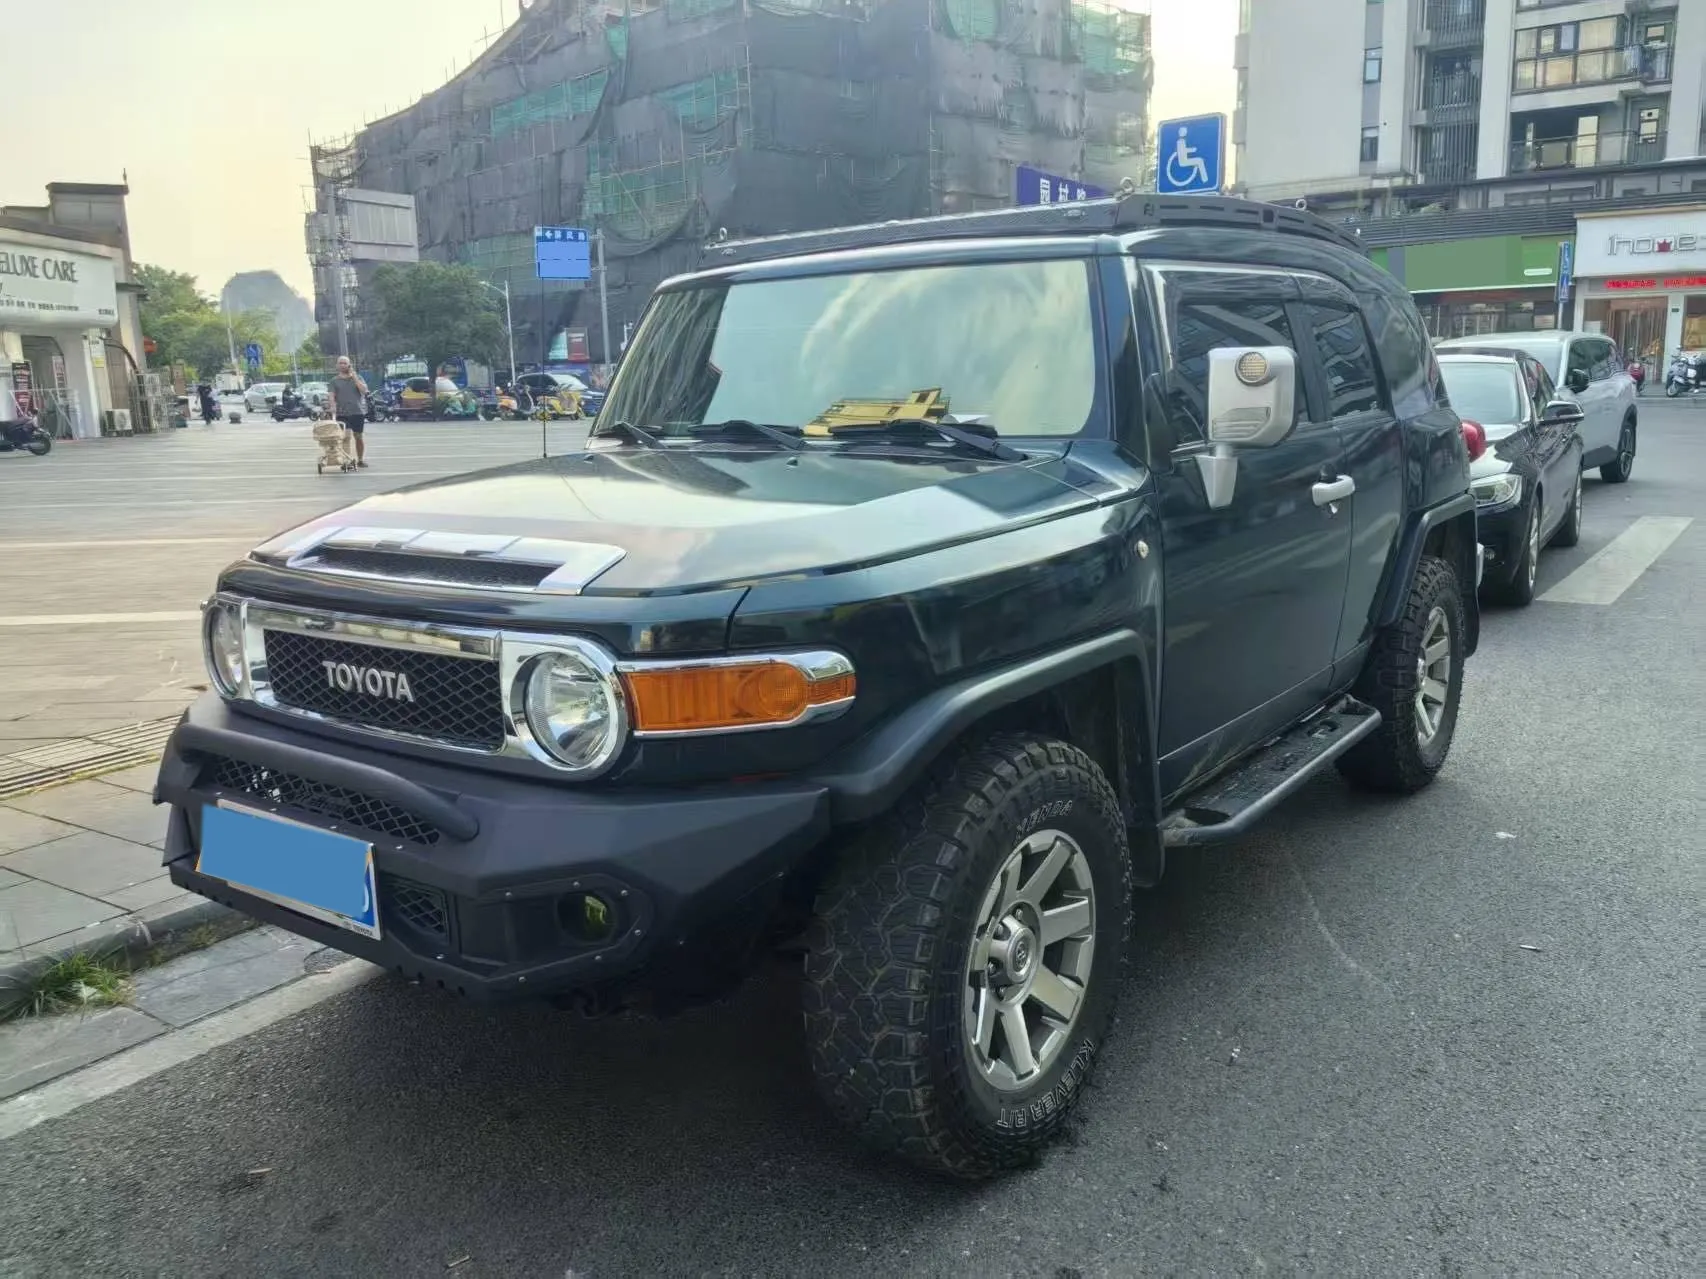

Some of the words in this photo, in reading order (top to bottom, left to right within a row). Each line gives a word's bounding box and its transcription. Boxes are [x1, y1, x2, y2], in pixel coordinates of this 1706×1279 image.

[42, 258, 79, 283] CARE
[322, 660, 414, 702] TOYOTA
[1030, 1038, 1096, 1122] KLEVER
